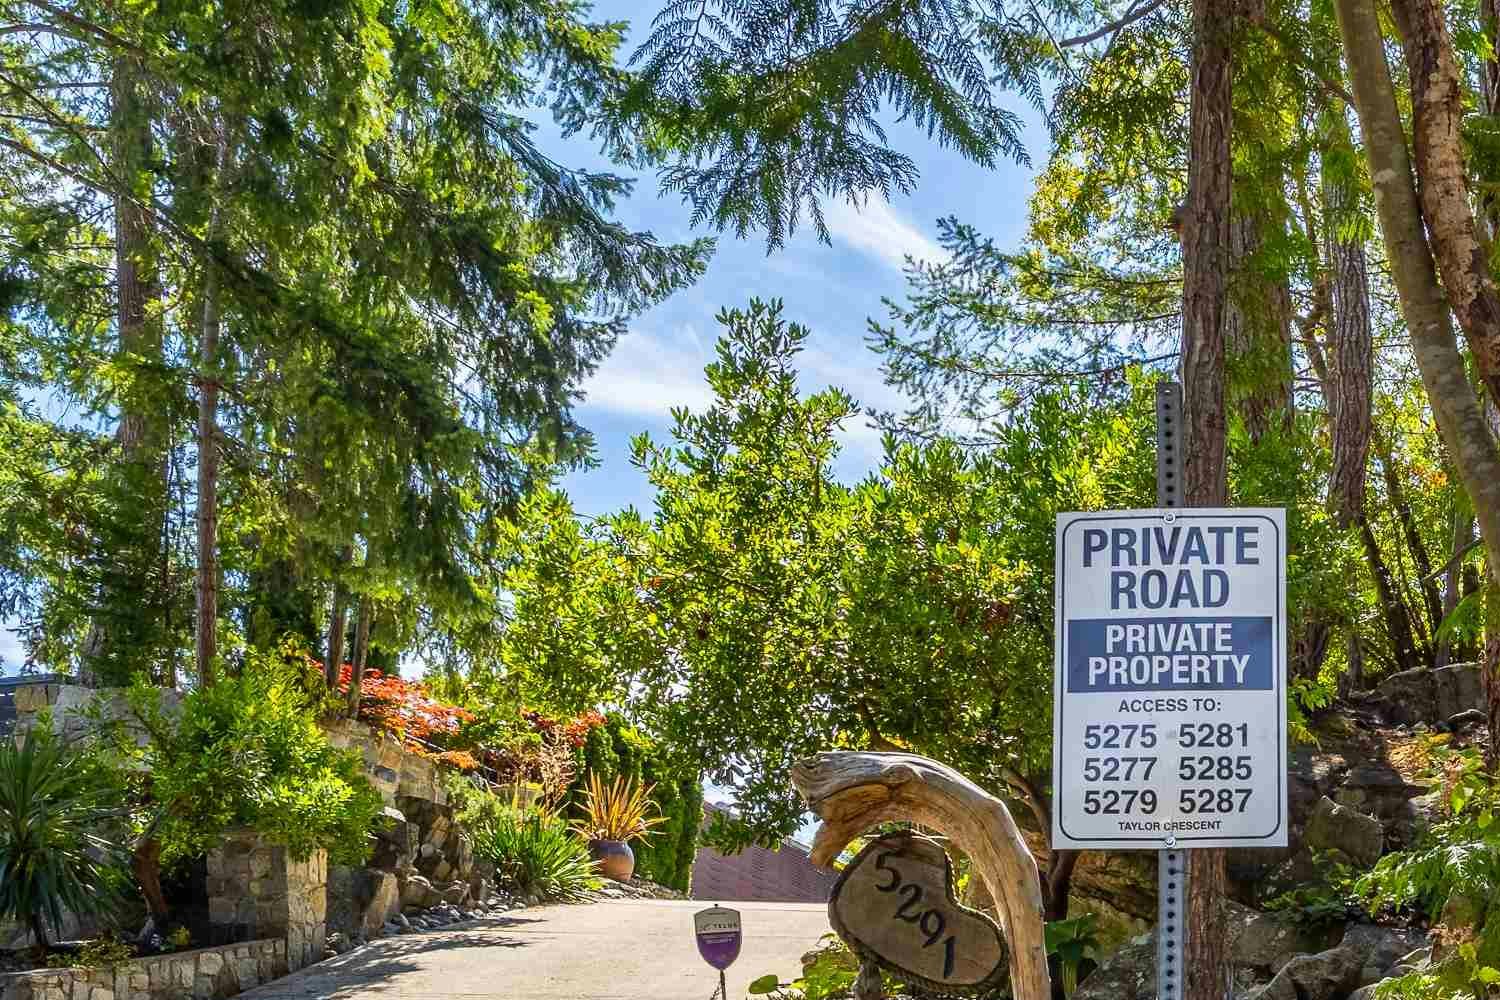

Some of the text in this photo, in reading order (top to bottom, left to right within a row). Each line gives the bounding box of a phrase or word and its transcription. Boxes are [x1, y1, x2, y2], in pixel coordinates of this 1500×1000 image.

[1083, 527, 1259, 567] PRIVATE
[1110, 569, 1229, 610] ROAD
[1105, 623, 1233, 654] PRIVATE
[1087, 655, 1251, 686] PROPERTY
[1118, 699, 1221, 713] ACCESS TO:
[1083, 723, 1250, 750] 5275 5281
[1083, 756, 1252, 783] 5277 5285
[1083, 788, 1253, 815] 5279 5287
[1118, 821, 1221, 832] TAYLOR CRESCENT
[874, 853, 955, 978] 5291
